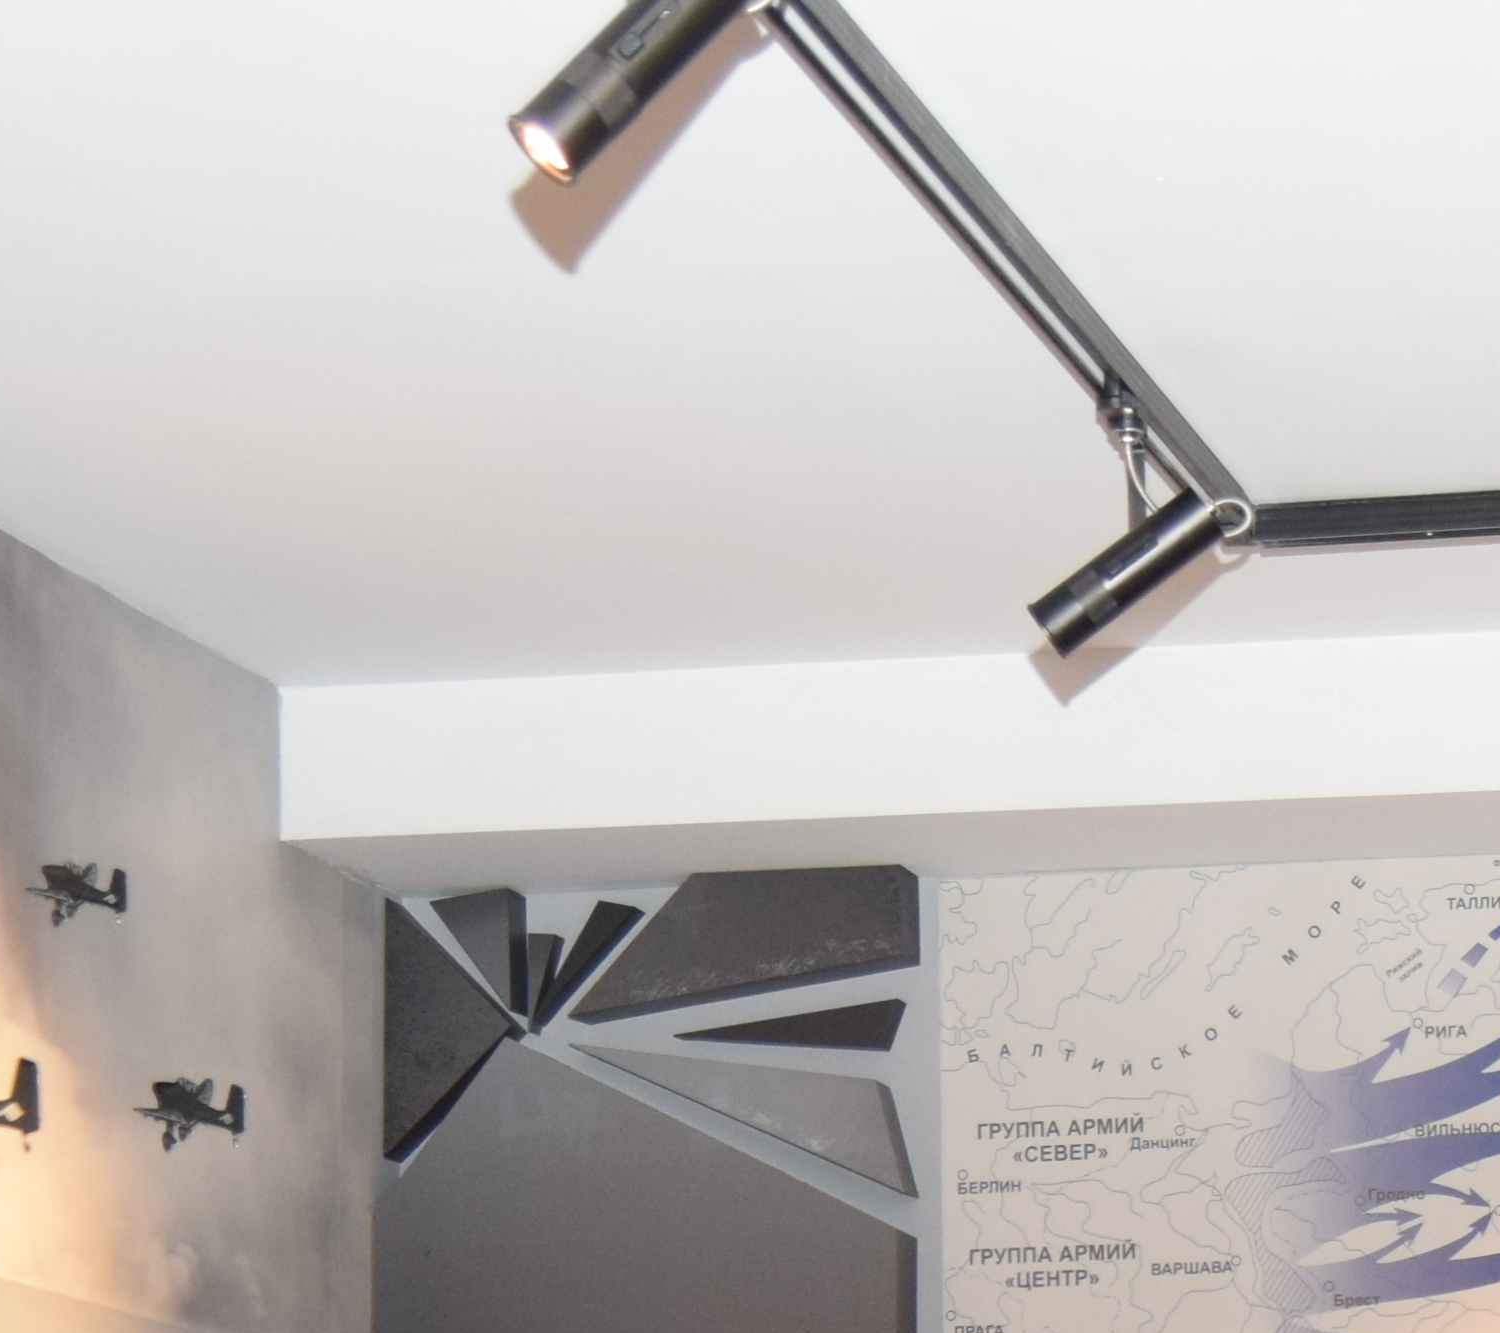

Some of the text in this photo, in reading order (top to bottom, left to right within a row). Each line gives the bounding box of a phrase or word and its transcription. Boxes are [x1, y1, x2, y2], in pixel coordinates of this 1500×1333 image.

[1424, 1025, 1467, 1040] РИГА
[977, 1113, 1144, 1140] ГРУППА АРМИЙ
[1414, 1121, 1500, 1139] ВИЛЬНЮС
[1013, 1144, 1108, 1163] «СЕВЕР»
[957, 1181, 1022, 1195] БЕРЛИН
[1367, 1187, 1426, 1204] Гродно
[969, 1239, 1136, 1265] ГРУППА АРМИЙ
[1151, 1261, 1232, 1276] ВАРШАВА
[1005, 1270, 1099, 1290] «ЦЕНТР»
[1334, 1292, 1380, 1309] Брест
